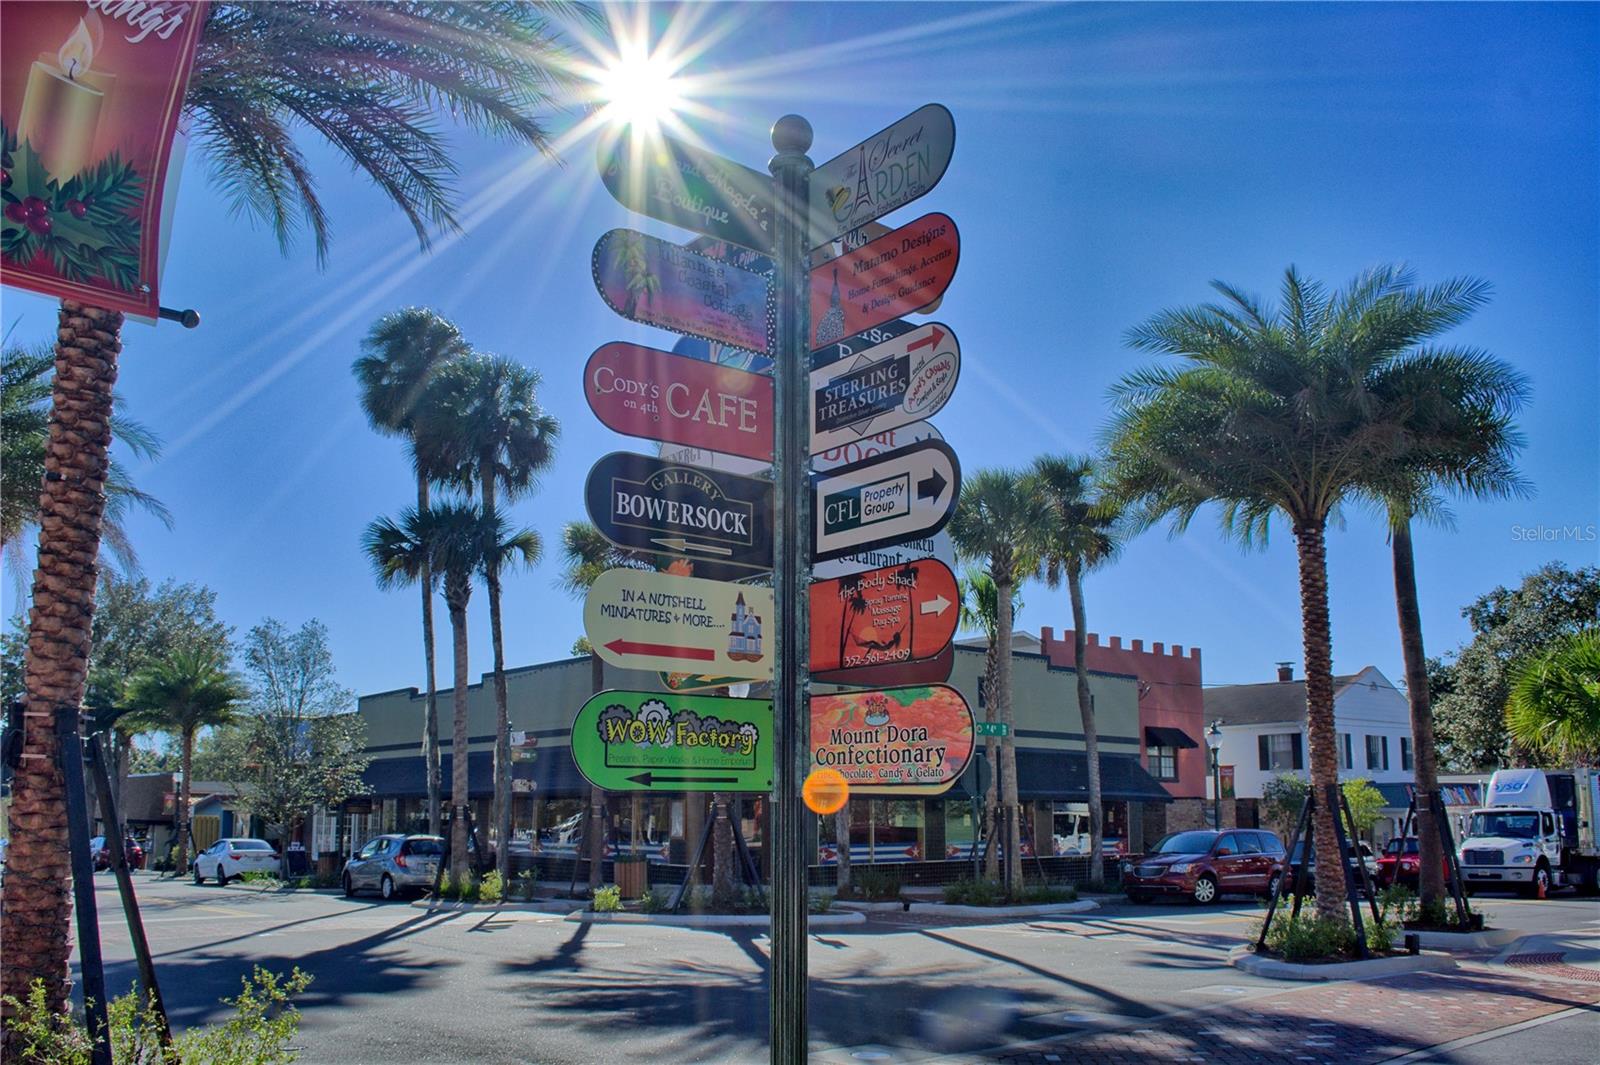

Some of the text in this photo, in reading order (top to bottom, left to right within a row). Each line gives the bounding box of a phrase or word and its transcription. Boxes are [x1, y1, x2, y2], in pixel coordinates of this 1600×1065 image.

[869, 126, 924, 172] Secret
[652, 174, 729, 226] Boutique
[902, 225, 947, 254] Designs
[848, 285, 870, 300] Home
[920, 248, 952, 271] Accents
[862, 276, 936, 314] & Design Guidance
[825, 363, 898, 403] STERLING
[624, 398, 659, 415] on 4th
[666, 382, 758, 433] CAFE
[818, 377, 906, 421] TREASURES
[651, 471, 721, 501] GALLERY
[864, 482, 904, 502] Property
[616, 492, 748, 535] BOWERSOCK
[825, 498, 859, 525] CFL
[864, 500, 895, 517] Group
[857, 572, 886, 592] Body
[887, 569, 918, 589] Shack
[622, 589, 706, 611] IN A NUTSHELL
[865, 592, 909, 609] Spray Tanning
[872, 604, 902, 617] Massage
[600, 604, 672, 624] MINIATURES
[844, 648, 911, 667] 352-561-2409
[674, 720, 753, 756] Factory
[830, 726, 928, 746] Mount Dora
[815, 745, 946, 767] Confectionary
[878, 767, 904, 780] Candy
[906, 769, 913, 778] &
[916, 767, 945, 778] Gelato
